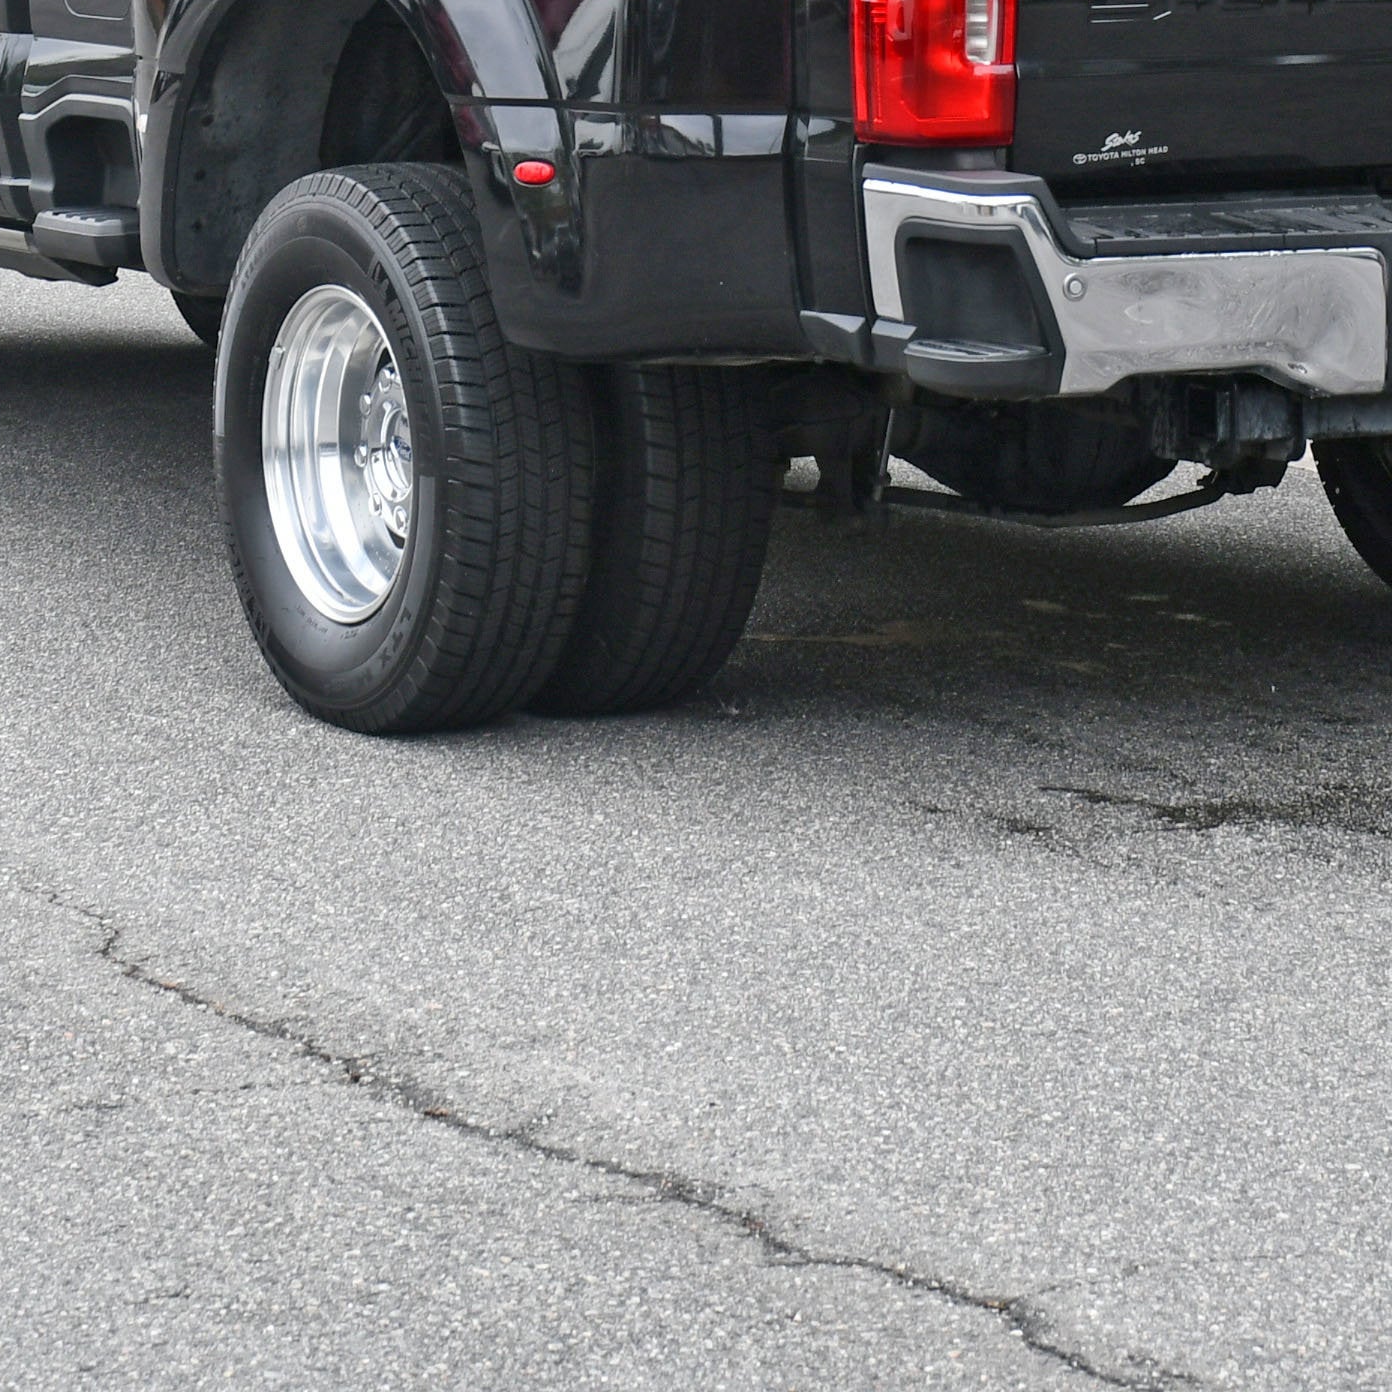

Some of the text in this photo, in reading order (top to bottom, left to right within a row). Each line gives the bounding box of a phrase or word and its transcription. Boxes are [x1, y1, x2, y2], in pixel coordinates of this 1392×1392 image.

[1088, 146, 1168, 162] TOYOTA HILTON HEAD
